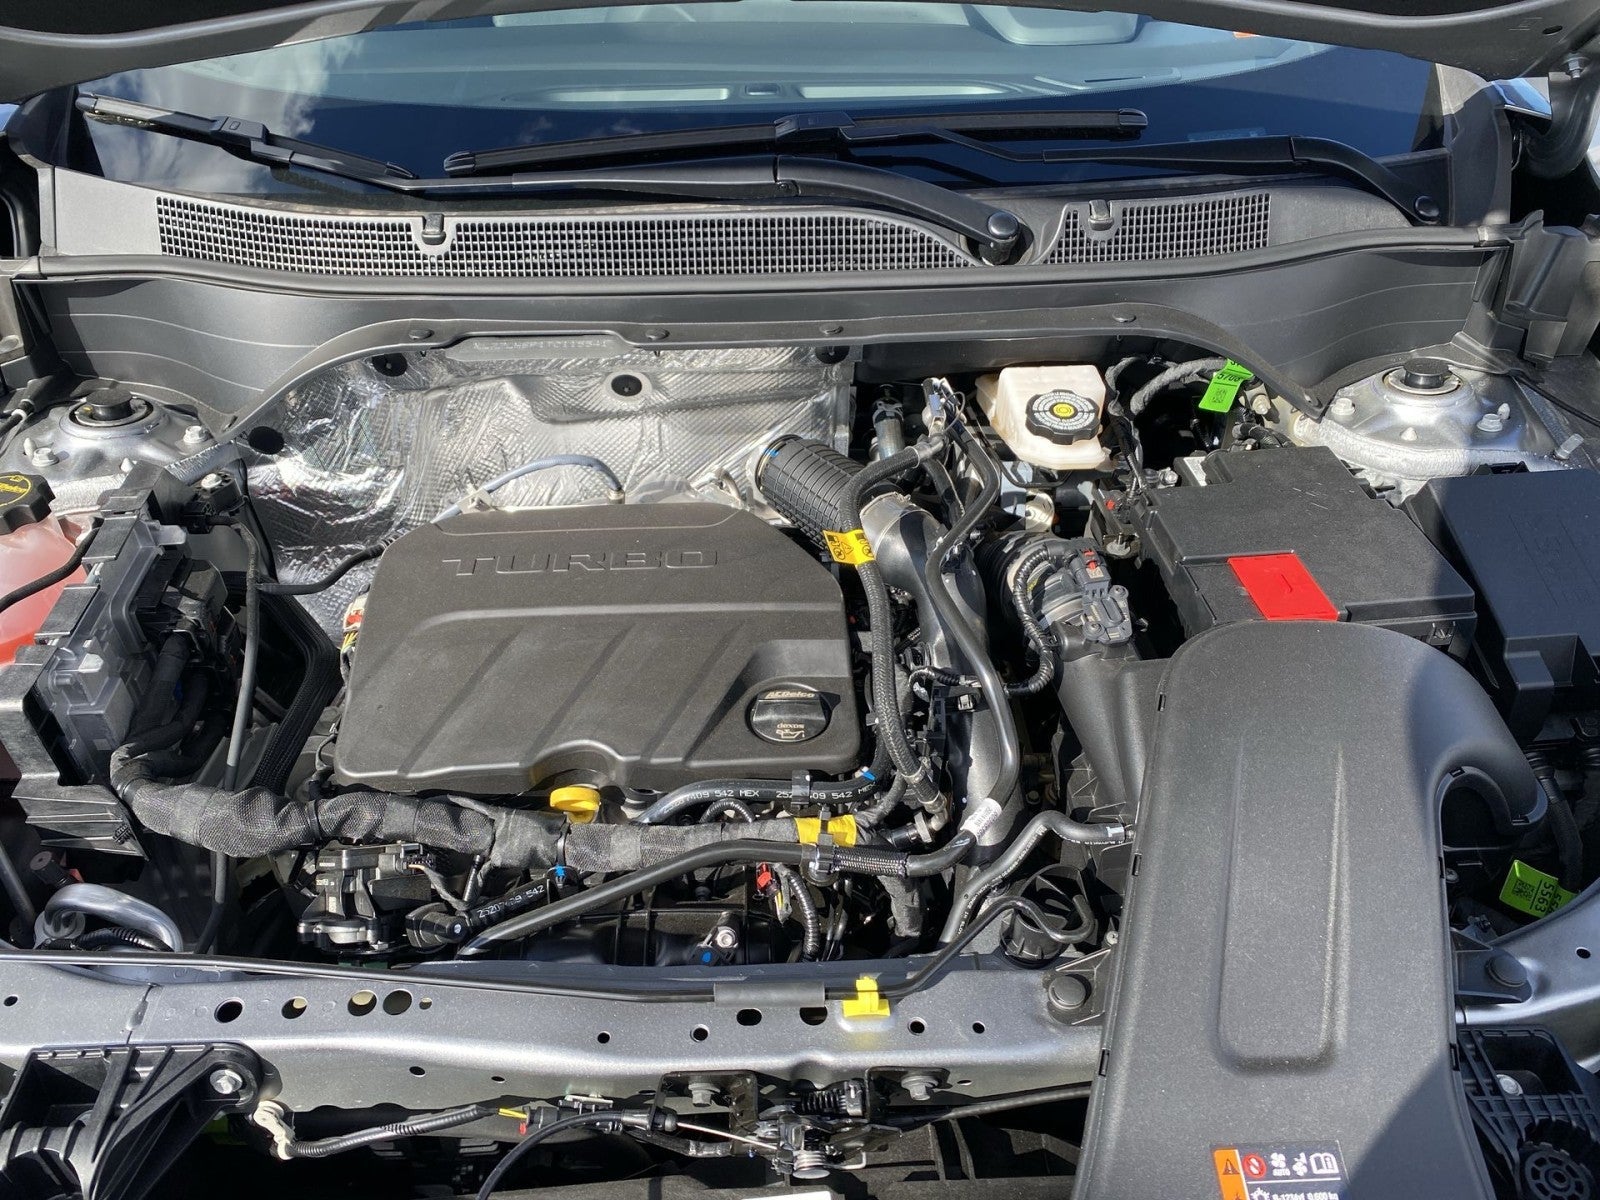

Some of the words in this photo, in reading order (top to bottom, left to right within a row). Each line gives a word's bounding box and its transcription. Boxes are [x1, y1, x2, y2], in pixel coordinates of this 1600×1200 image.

[441, 551, 718, 576] TURBO
[764, 691, 816, 700] ACDelco
[714, 789, 735, 798] 542
[739, 789, 760, 798] MEX
[775, 790, 827, 800] 25209
[831, 790, 853, 800] 542
[525, 884, 545, 898] 542
[1534, 881, 1555, 913] 5563
